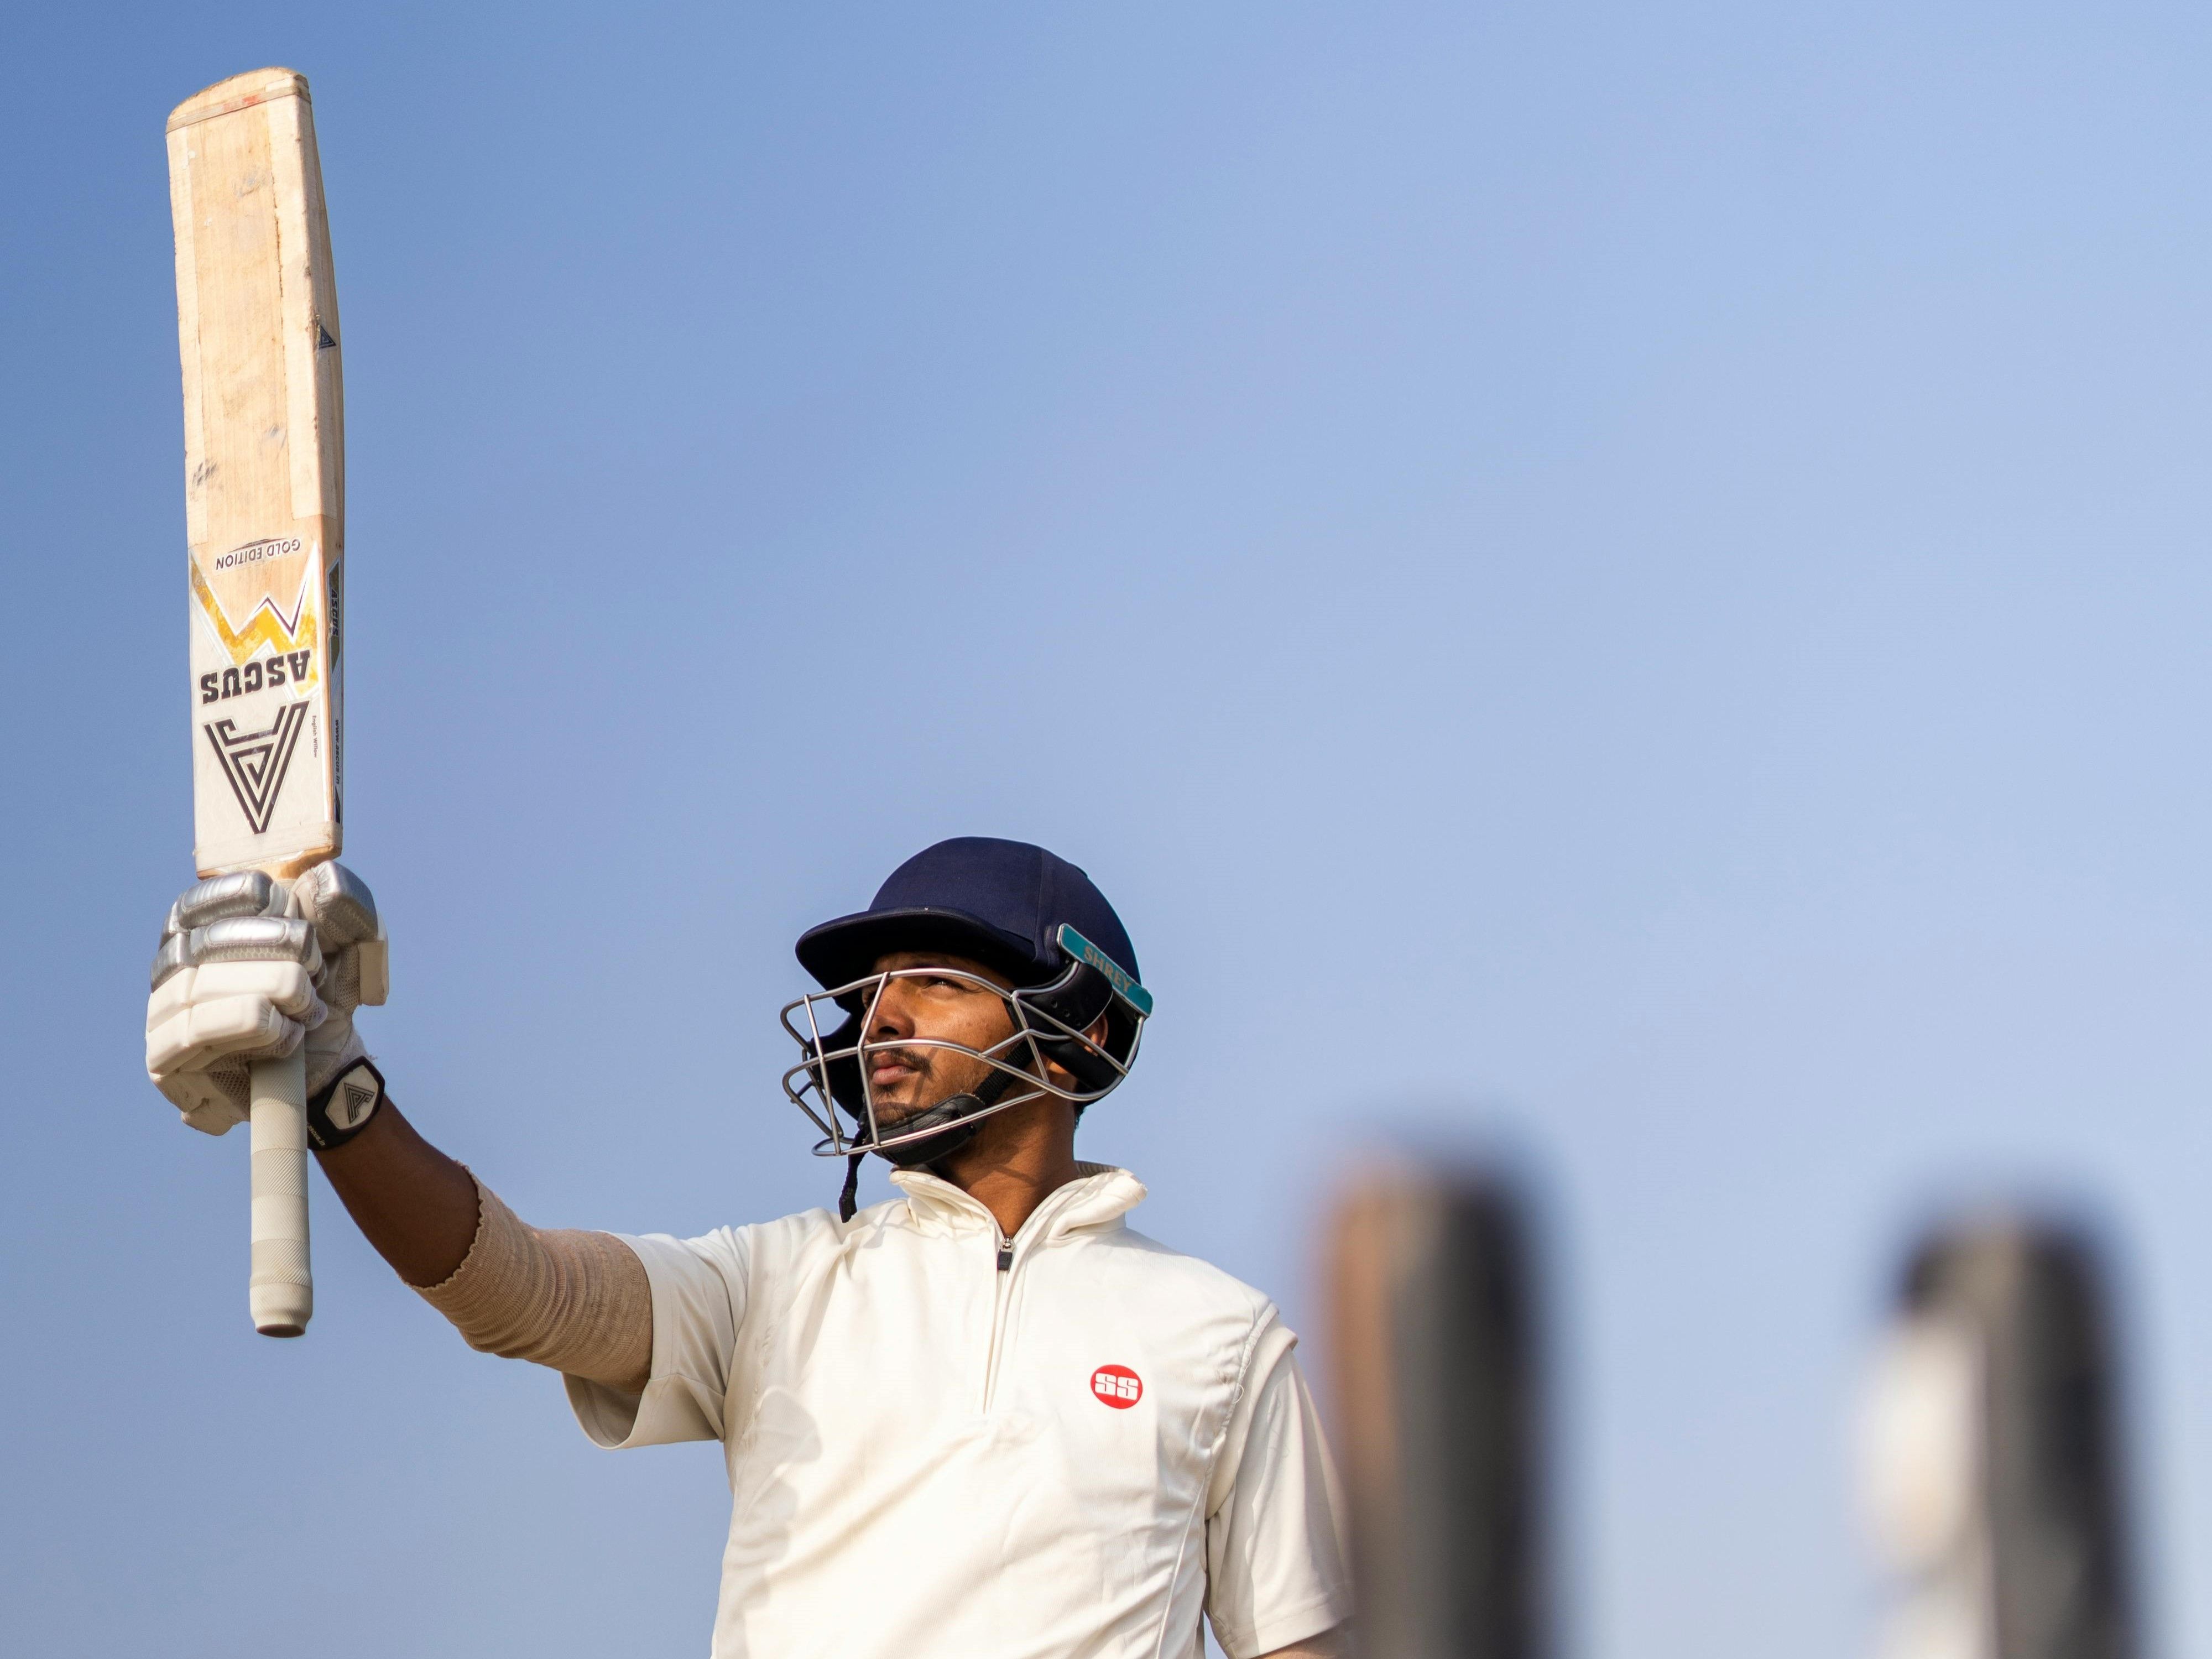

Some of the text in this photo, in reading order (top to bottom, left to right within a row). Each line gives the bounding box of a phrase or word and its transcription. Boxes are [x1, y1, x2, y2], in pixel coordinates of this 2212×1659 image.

[216, 539, 300, 570] GOLD EDITION
[200, 649, 310, 705] ASCUS
[1084, 946, 1131, 992] SHREY
[1095, 1373, 1139, 1401] SS
